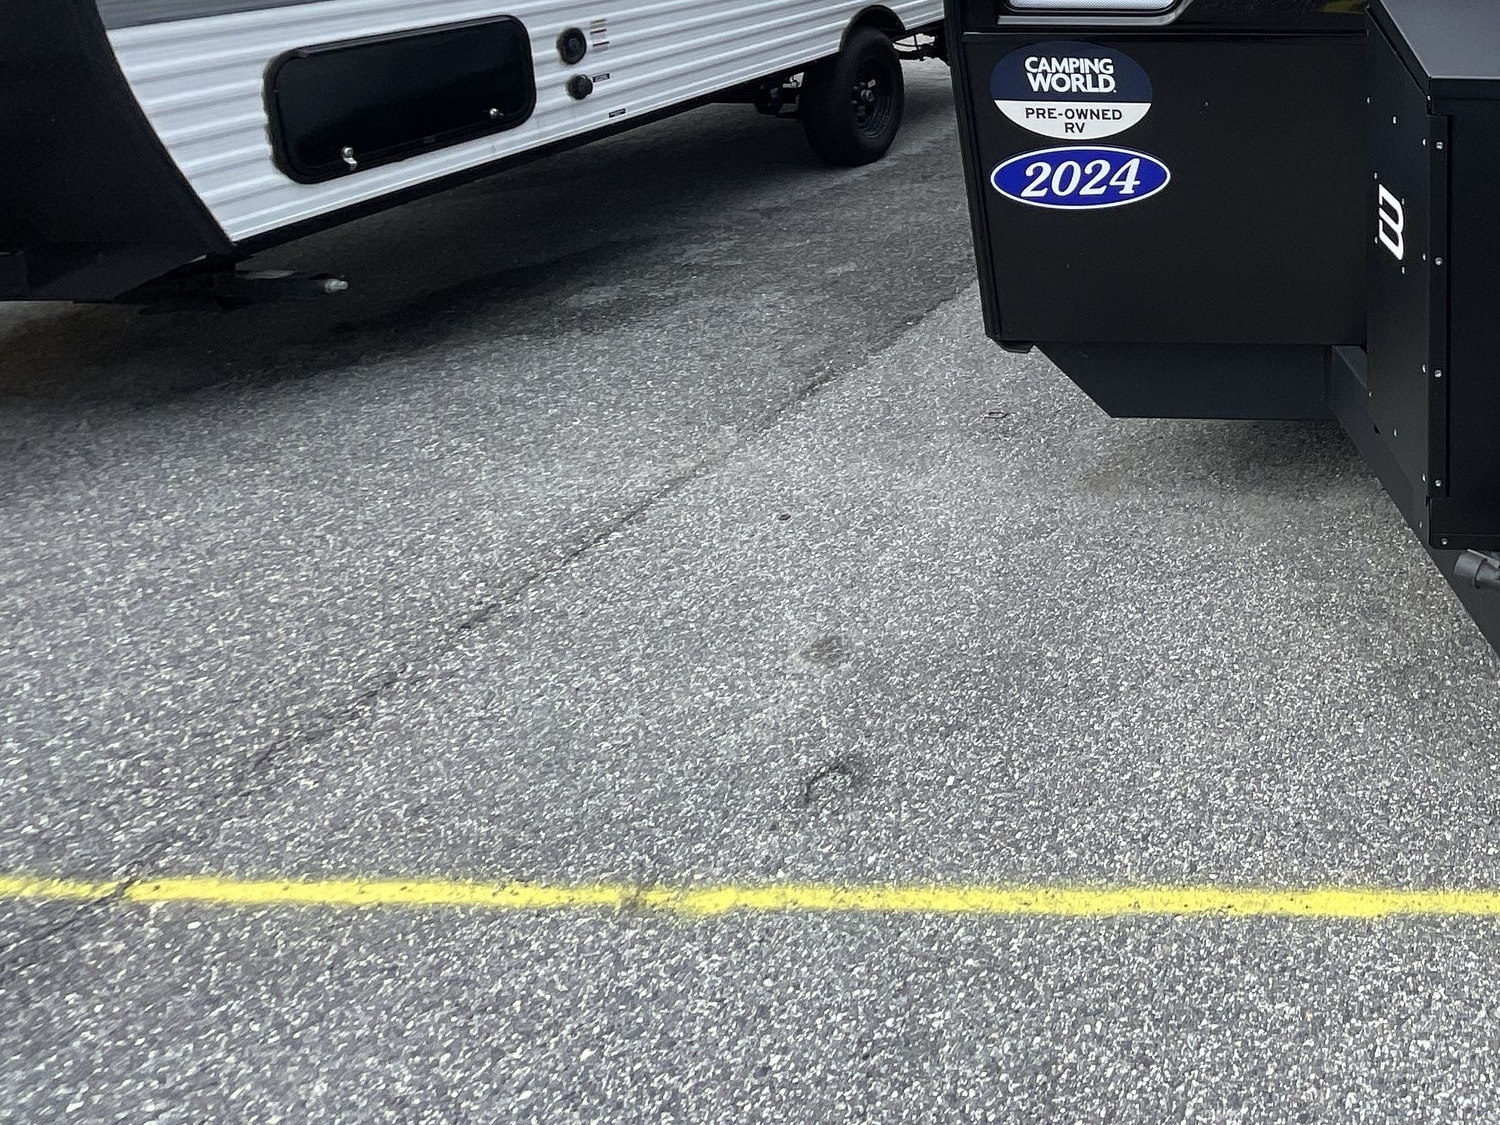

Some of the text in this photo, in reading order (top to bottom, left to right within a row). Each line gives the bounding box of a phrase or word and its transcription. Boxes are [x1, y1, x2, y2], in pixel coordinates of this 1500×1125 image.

[1024, 56, 1114, 74] CAMPING
[1025, 107, 1122, 120] PRE-OWNED
[1065, 122, 1085, 134] RV
[1020, 158, 1141, 197] 2024
